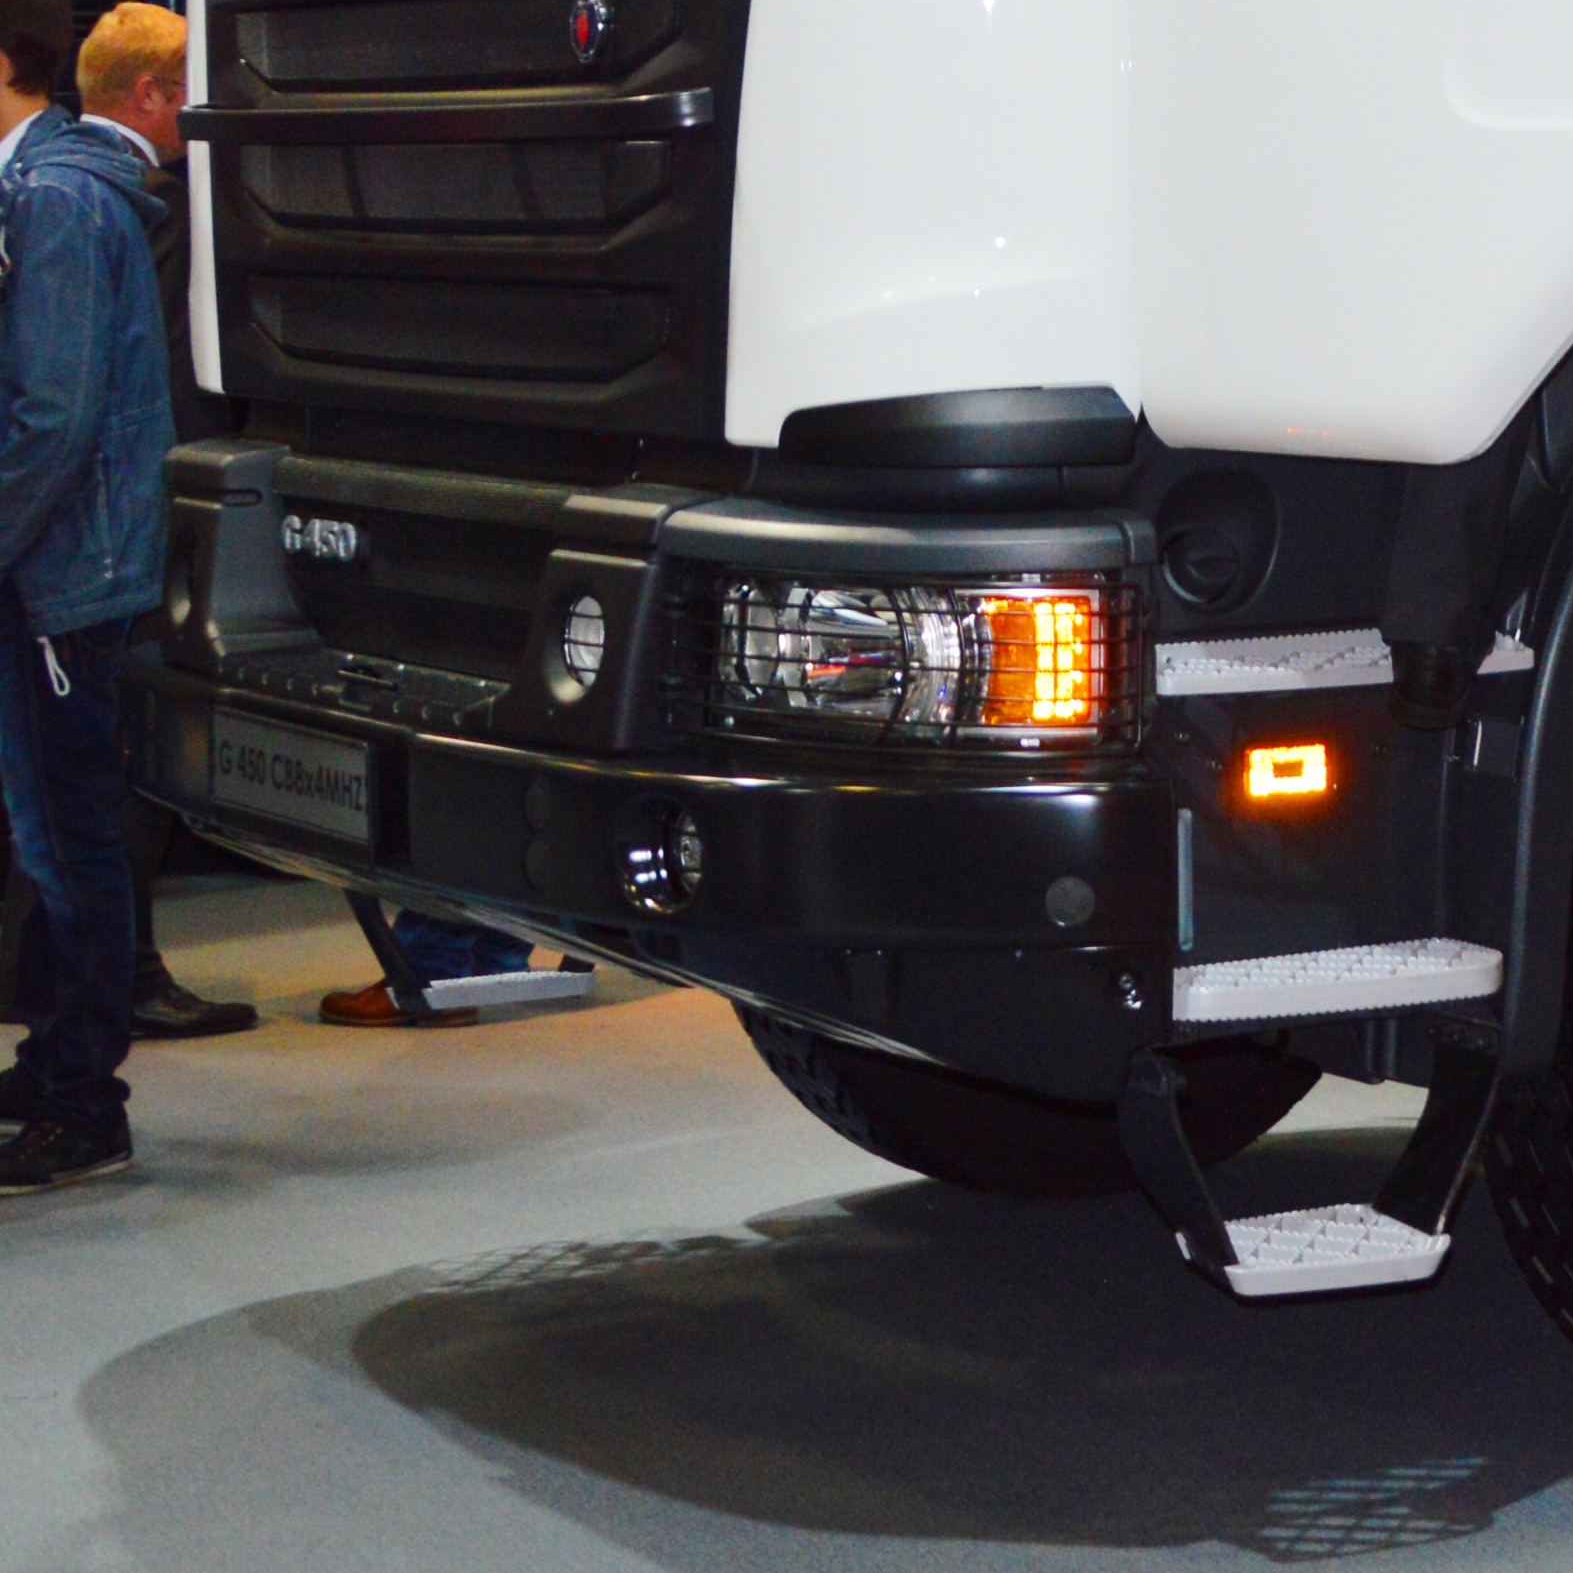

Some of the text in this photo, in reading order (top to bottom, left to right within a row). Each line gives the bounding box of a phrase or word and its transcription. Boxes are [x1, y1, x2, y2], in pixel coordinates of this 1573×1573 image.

[304, 518, 357, 561] 450
[218, 740, 232, 775] G
[237, 745, 266, 785] 450
